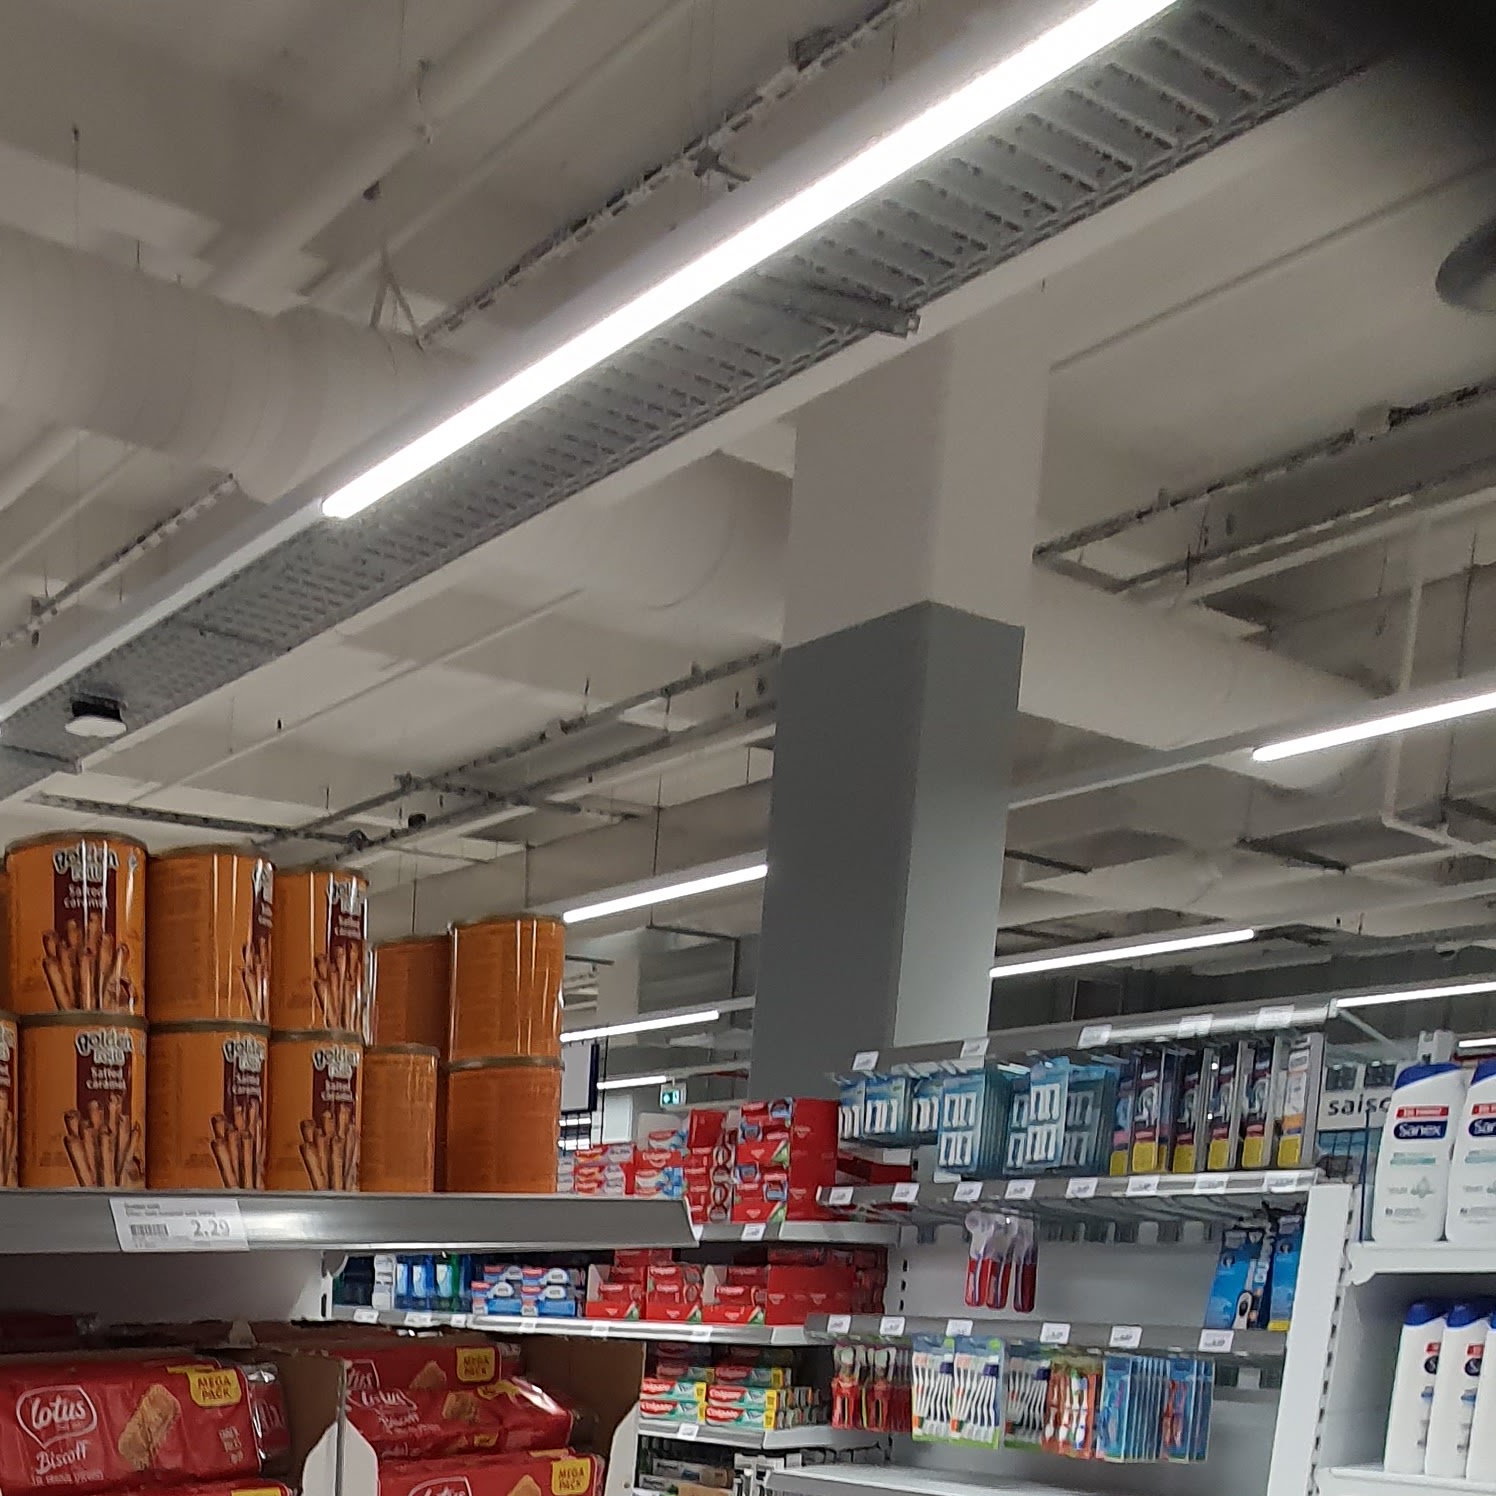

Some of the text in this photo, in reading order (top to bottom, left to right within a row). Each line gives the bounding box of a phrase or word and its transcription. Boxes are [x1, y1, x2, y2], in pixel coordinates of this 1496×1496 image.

[1399, 1122, 1442, 1138] Sanex
[1474, 1119, 1496, 1136] San
[191, 1218, 231, 1238] 2.29
[196, 1375, 232, 1389] MEGA
[199, 1386, 232, 1400] PACK
[31, 1394, 86, 1430] Lotus
[36, 1439, 90, 1475] Biscoff
